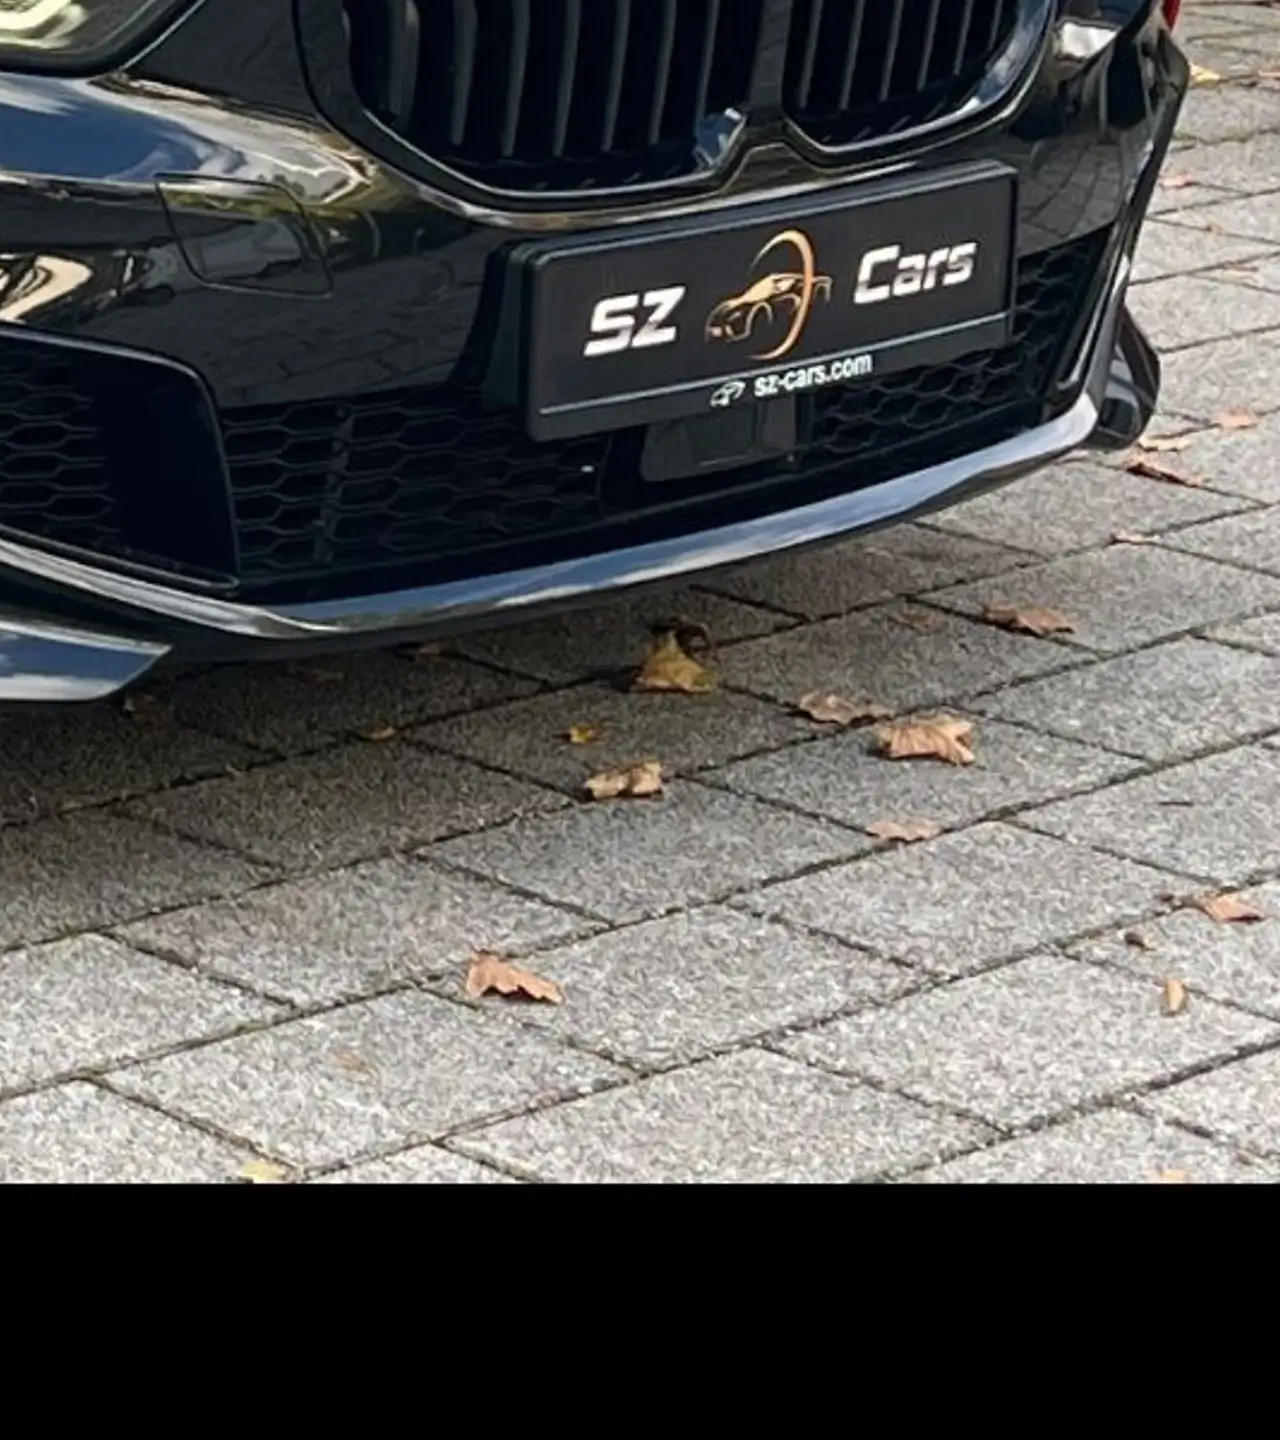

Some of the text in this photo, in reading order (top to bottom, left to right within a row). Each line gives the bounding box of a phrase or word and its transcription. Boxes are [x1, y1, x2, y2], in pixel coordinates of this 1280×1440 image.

[583, 242, 977, 357] SZ Cars
[754, 354, 873, 397] sz-cars.com
